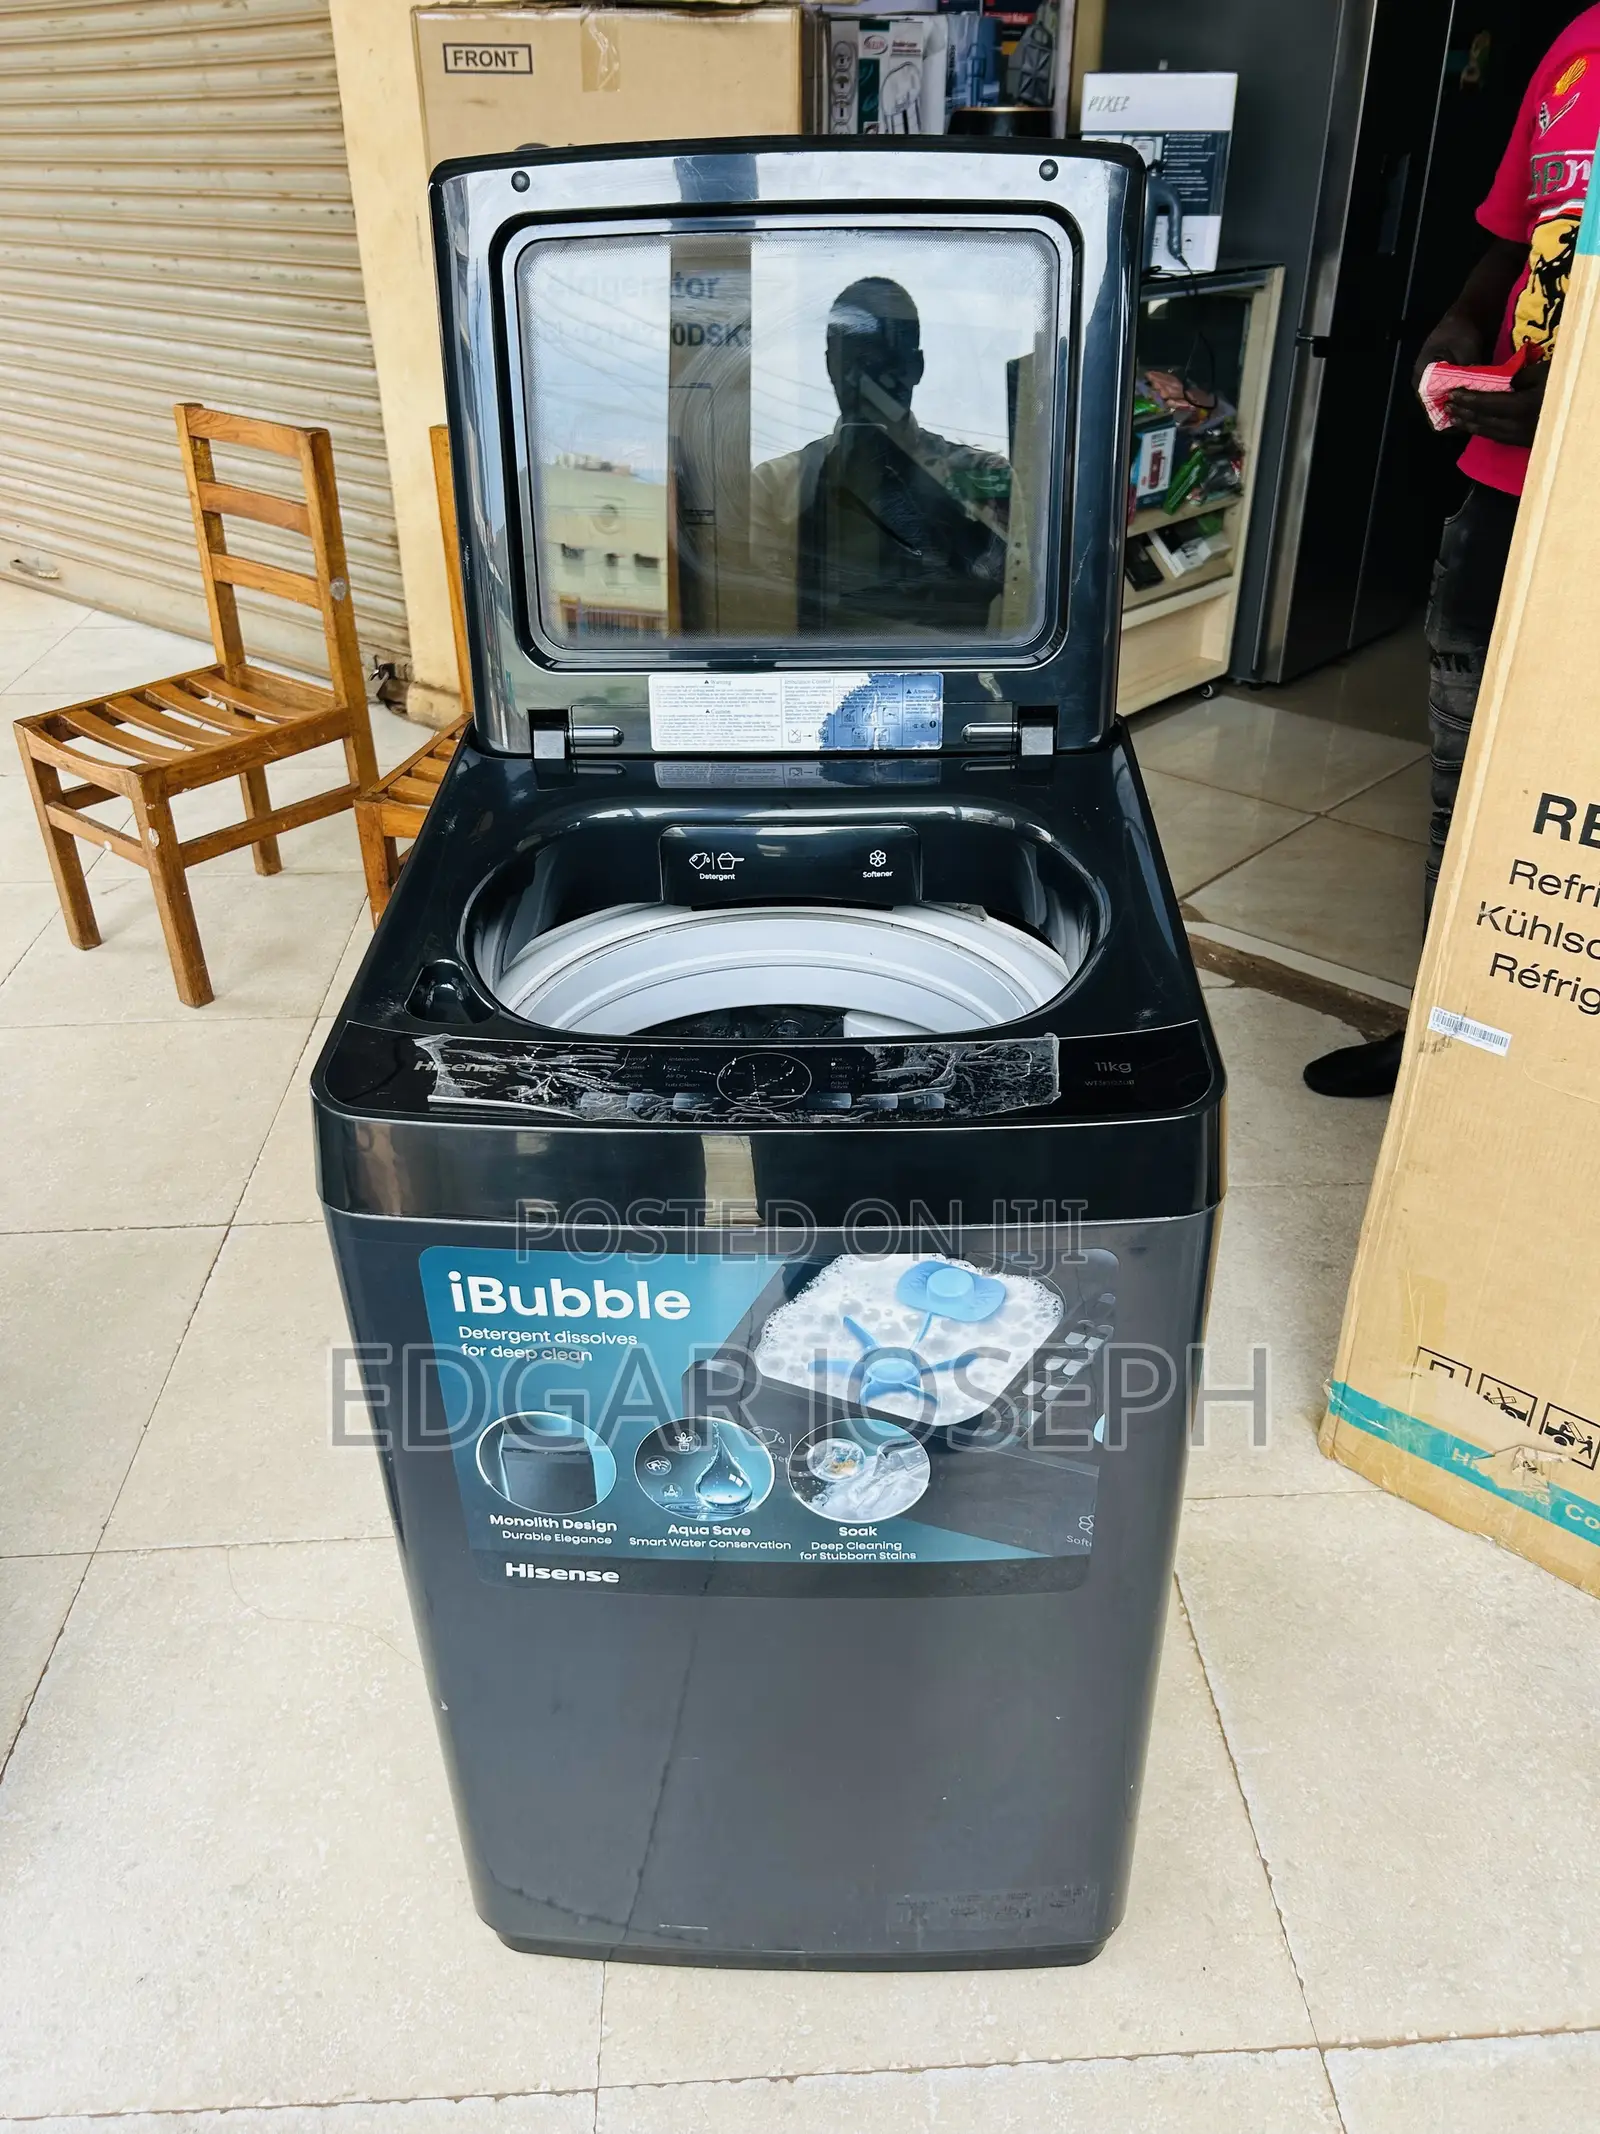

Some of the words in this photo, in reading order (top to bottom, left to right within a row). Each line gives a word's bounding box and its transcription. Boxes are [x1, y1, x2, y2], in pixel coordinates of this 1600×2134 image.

[452, 50, 519, 68] FRONT
[699, 872, 736, 881] Detergent
[862, 870, 893, 878] Softener
[1094, 1061, 1132, 1074] 11kg
[448, 1270, 692, 1320] iBubble
[458, 1325, 551, 1344] Detergent
[554, 1330, 638, 1346] dissolves
[460, 1343, 487, 1357] for
[490, 1345, 538, 1362] deep
[541, 1347, 593, 1362] clean
[489, 1514, 559, 1529] Monolith
[563, 1518, 618, 1533] Design
[667, 1523, 710, 1537] Aqua
[713, 1524, 751, 1537] Save
[502, 1529, 552, 1542] Durable
[555, 1533, 613, 1546] Elegance
[838, 1525, 878, 1538] Soak
[629, 1536, 667, 1548] Smart
[668, 1537, 706, 1549] Water
[709, 1538, 792, 1550] Conservation
[811, 1541, 845, 1553] Deep
[846, 1540, 903, 1553] Cleaning
[799, 1550, 818, 1561] for
[819, 1550, 877, 1561] Stubborn
[879, 1550, 917, 1561] Stains
[505, 1561, 620, 1584] Hisense
